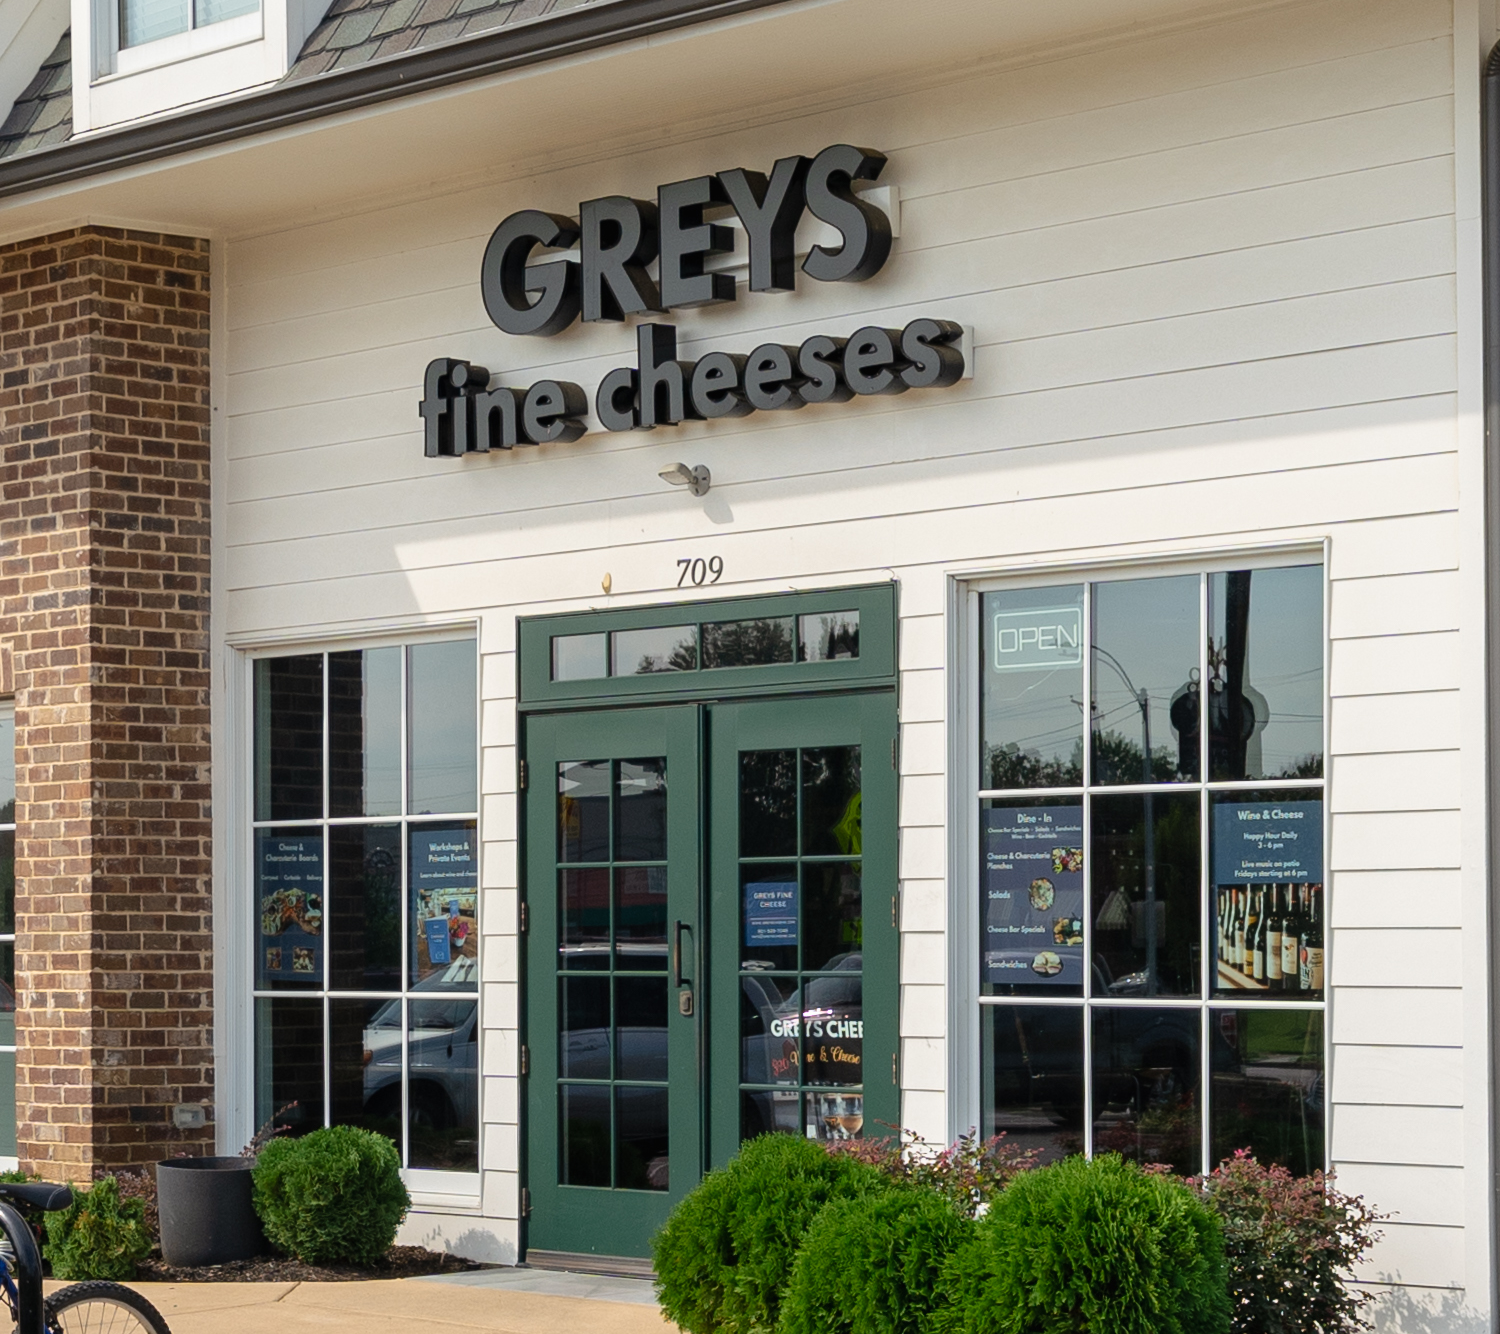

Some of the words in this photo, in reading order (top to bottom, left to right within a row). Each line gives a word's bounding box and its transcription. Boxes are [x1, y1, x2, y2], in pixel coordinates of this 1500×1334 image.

[481, 144, 892, 336] GREYS
[420, 357, 588, 457] fine
[596, 318, 965, 433] cheeses
[676, 555, 723, 587] 709
[999, 624, 1077, 652] OPEN
[1017, 813, 1036, 823] Dine
[1044, 813, 1052, 823] In
[1238, 811, 1261, 820] Wine
[1263, 810, 1270, 819] &
[1272, 809, 1304, 819] Cheese
[1244, 833, 1264, 841] Happy
[1282, 831, 1298, 840] Daily
[429, 842, 462, 853] Workshops
[1009, 852, 1014, 860] &
[1256, 860, 1273, 868] music
[1283, 860, 1300, 868] patio
[1235, 870, 1257, 878] Fridays
[1259, 870, 1283, 878] starting
[1292, 869, 1297, 877] 6
[777, 891, 793, 899] FINE
[988, 890, 1011, 899] Salads
[987, 925, 1009, 933] Cheese
[1009, 925, 1020, 933] Bar
[988, 960, 1028, 969] Sandwiches
[831, 1046, 861, 1065] Cheese
